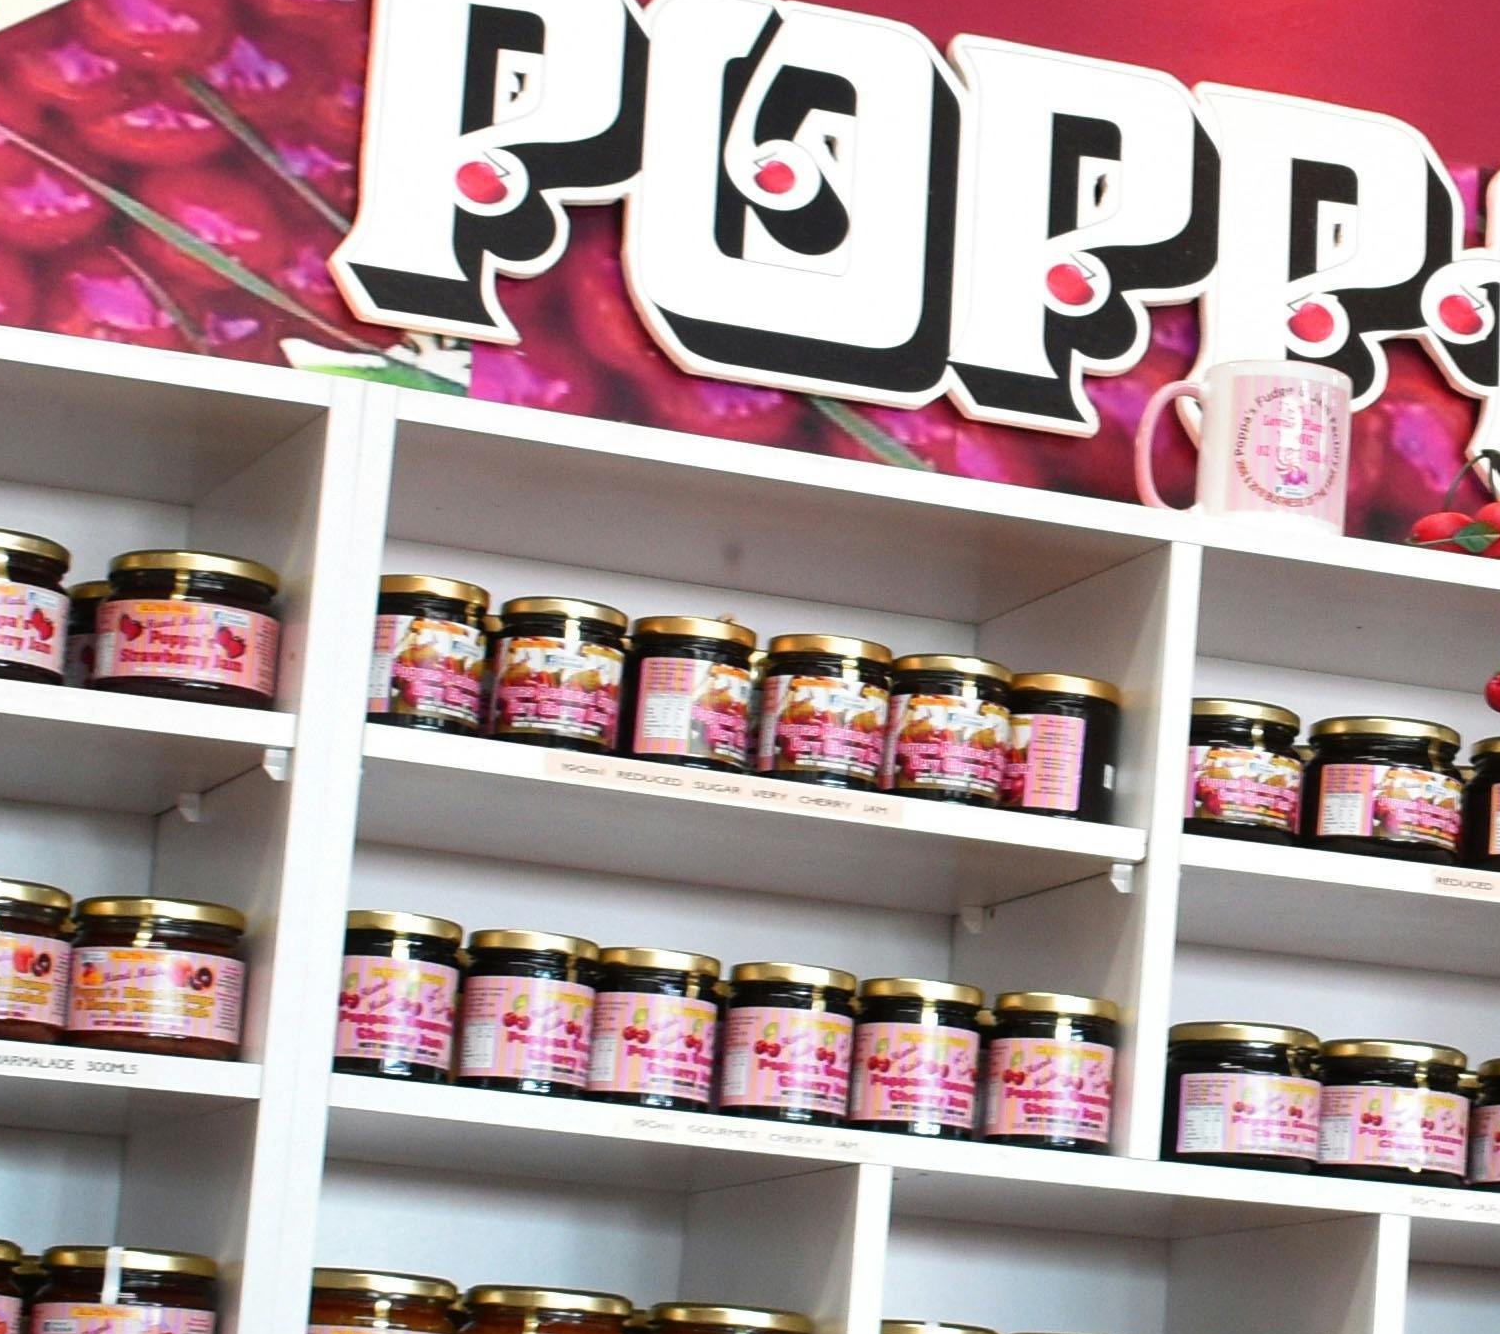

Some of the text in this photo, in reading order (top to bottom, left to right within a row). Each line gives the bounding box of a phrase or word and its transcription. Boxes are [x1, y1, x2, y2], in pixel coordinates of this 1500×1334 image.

[693, 779, 740, 795] SUGAR
[751, 789, 787, 801] VERY
[800, 795, 852, 811] CHERRY
